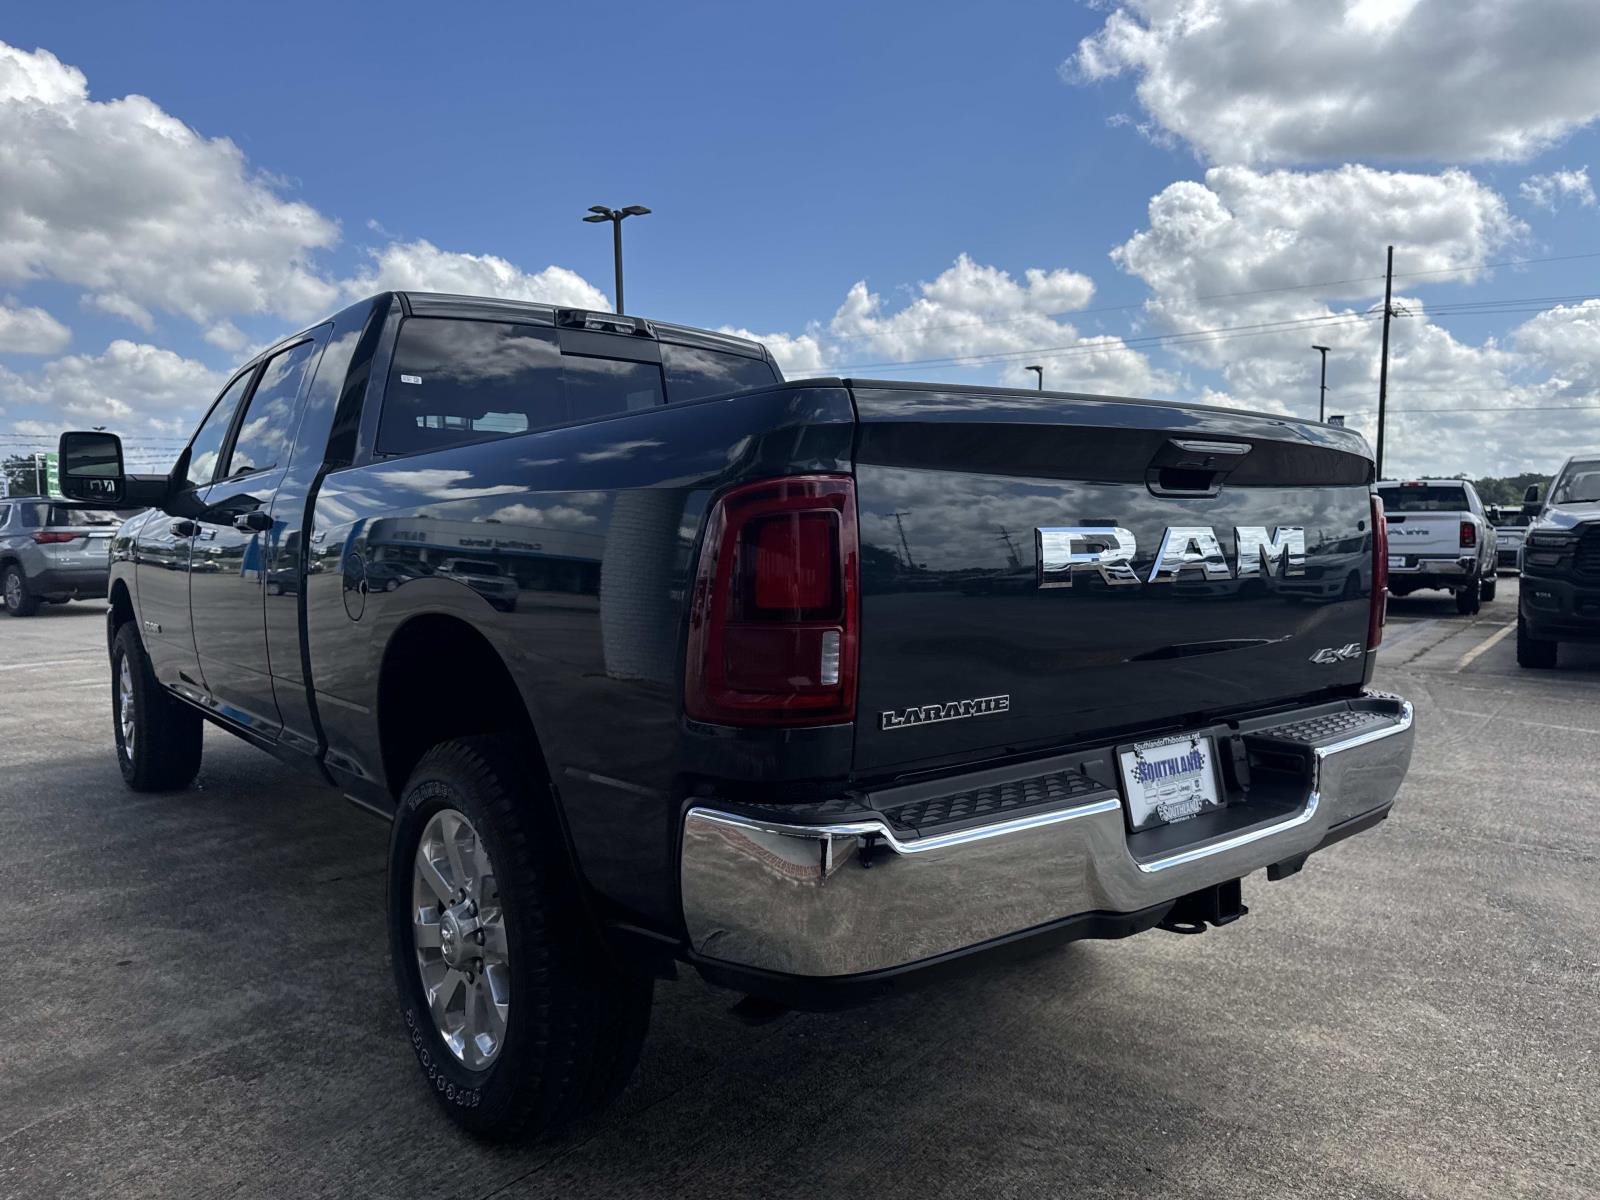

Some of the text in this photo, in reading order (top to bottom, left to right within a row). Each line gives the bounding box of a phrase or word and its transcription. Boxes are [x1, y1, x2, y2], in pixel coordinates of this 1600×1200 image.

[1035, 526, 1305, 589] RAM
[882, 695, 1009, 730] LARAMIE
[1139, 751, 1201, 783] SOUTHLAND
[1163, 797, 1200, 821] SOUTHLAND
